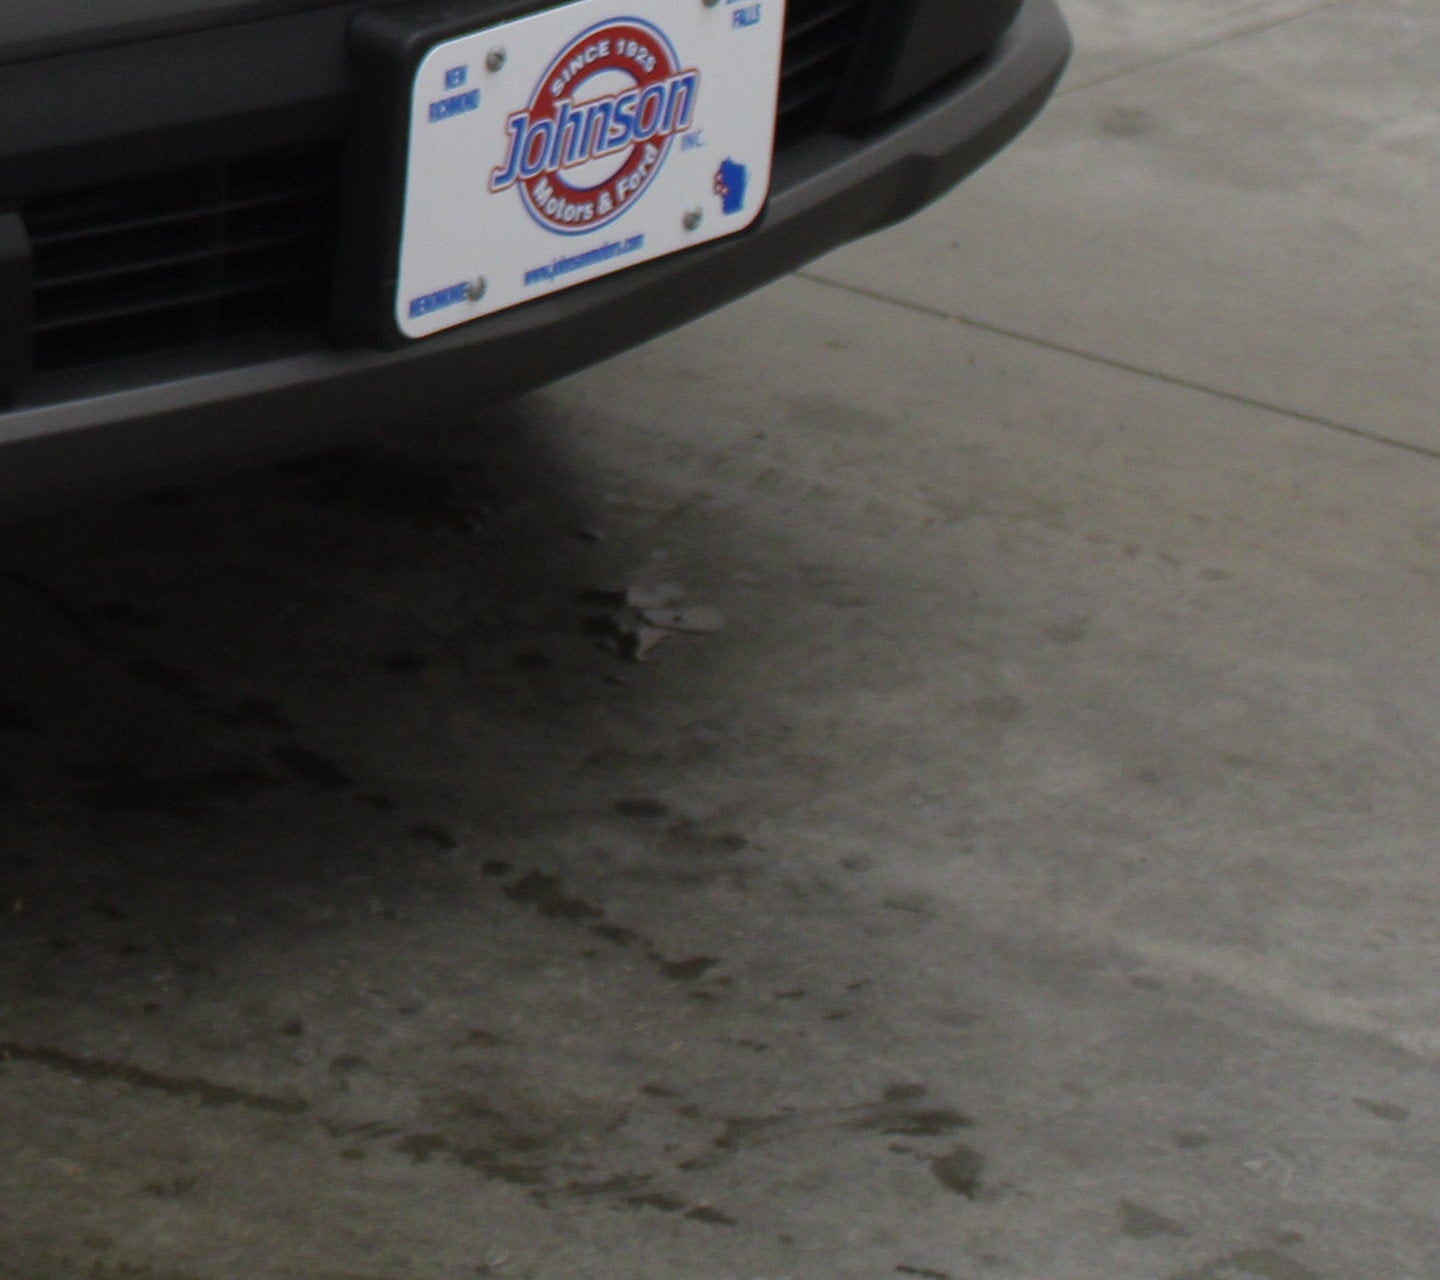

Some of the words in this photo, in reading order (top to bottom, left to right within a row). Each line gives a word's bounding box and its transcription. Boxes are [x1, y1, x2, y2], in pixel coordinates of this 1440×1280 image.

[549, 38, 611, 97] SINCE
[490, 69, 700, 192] Johnson
[533, 176, 594, 222] Motors
[598, 191, 614, 214] &
[616, 144, 659, 202] Ford
